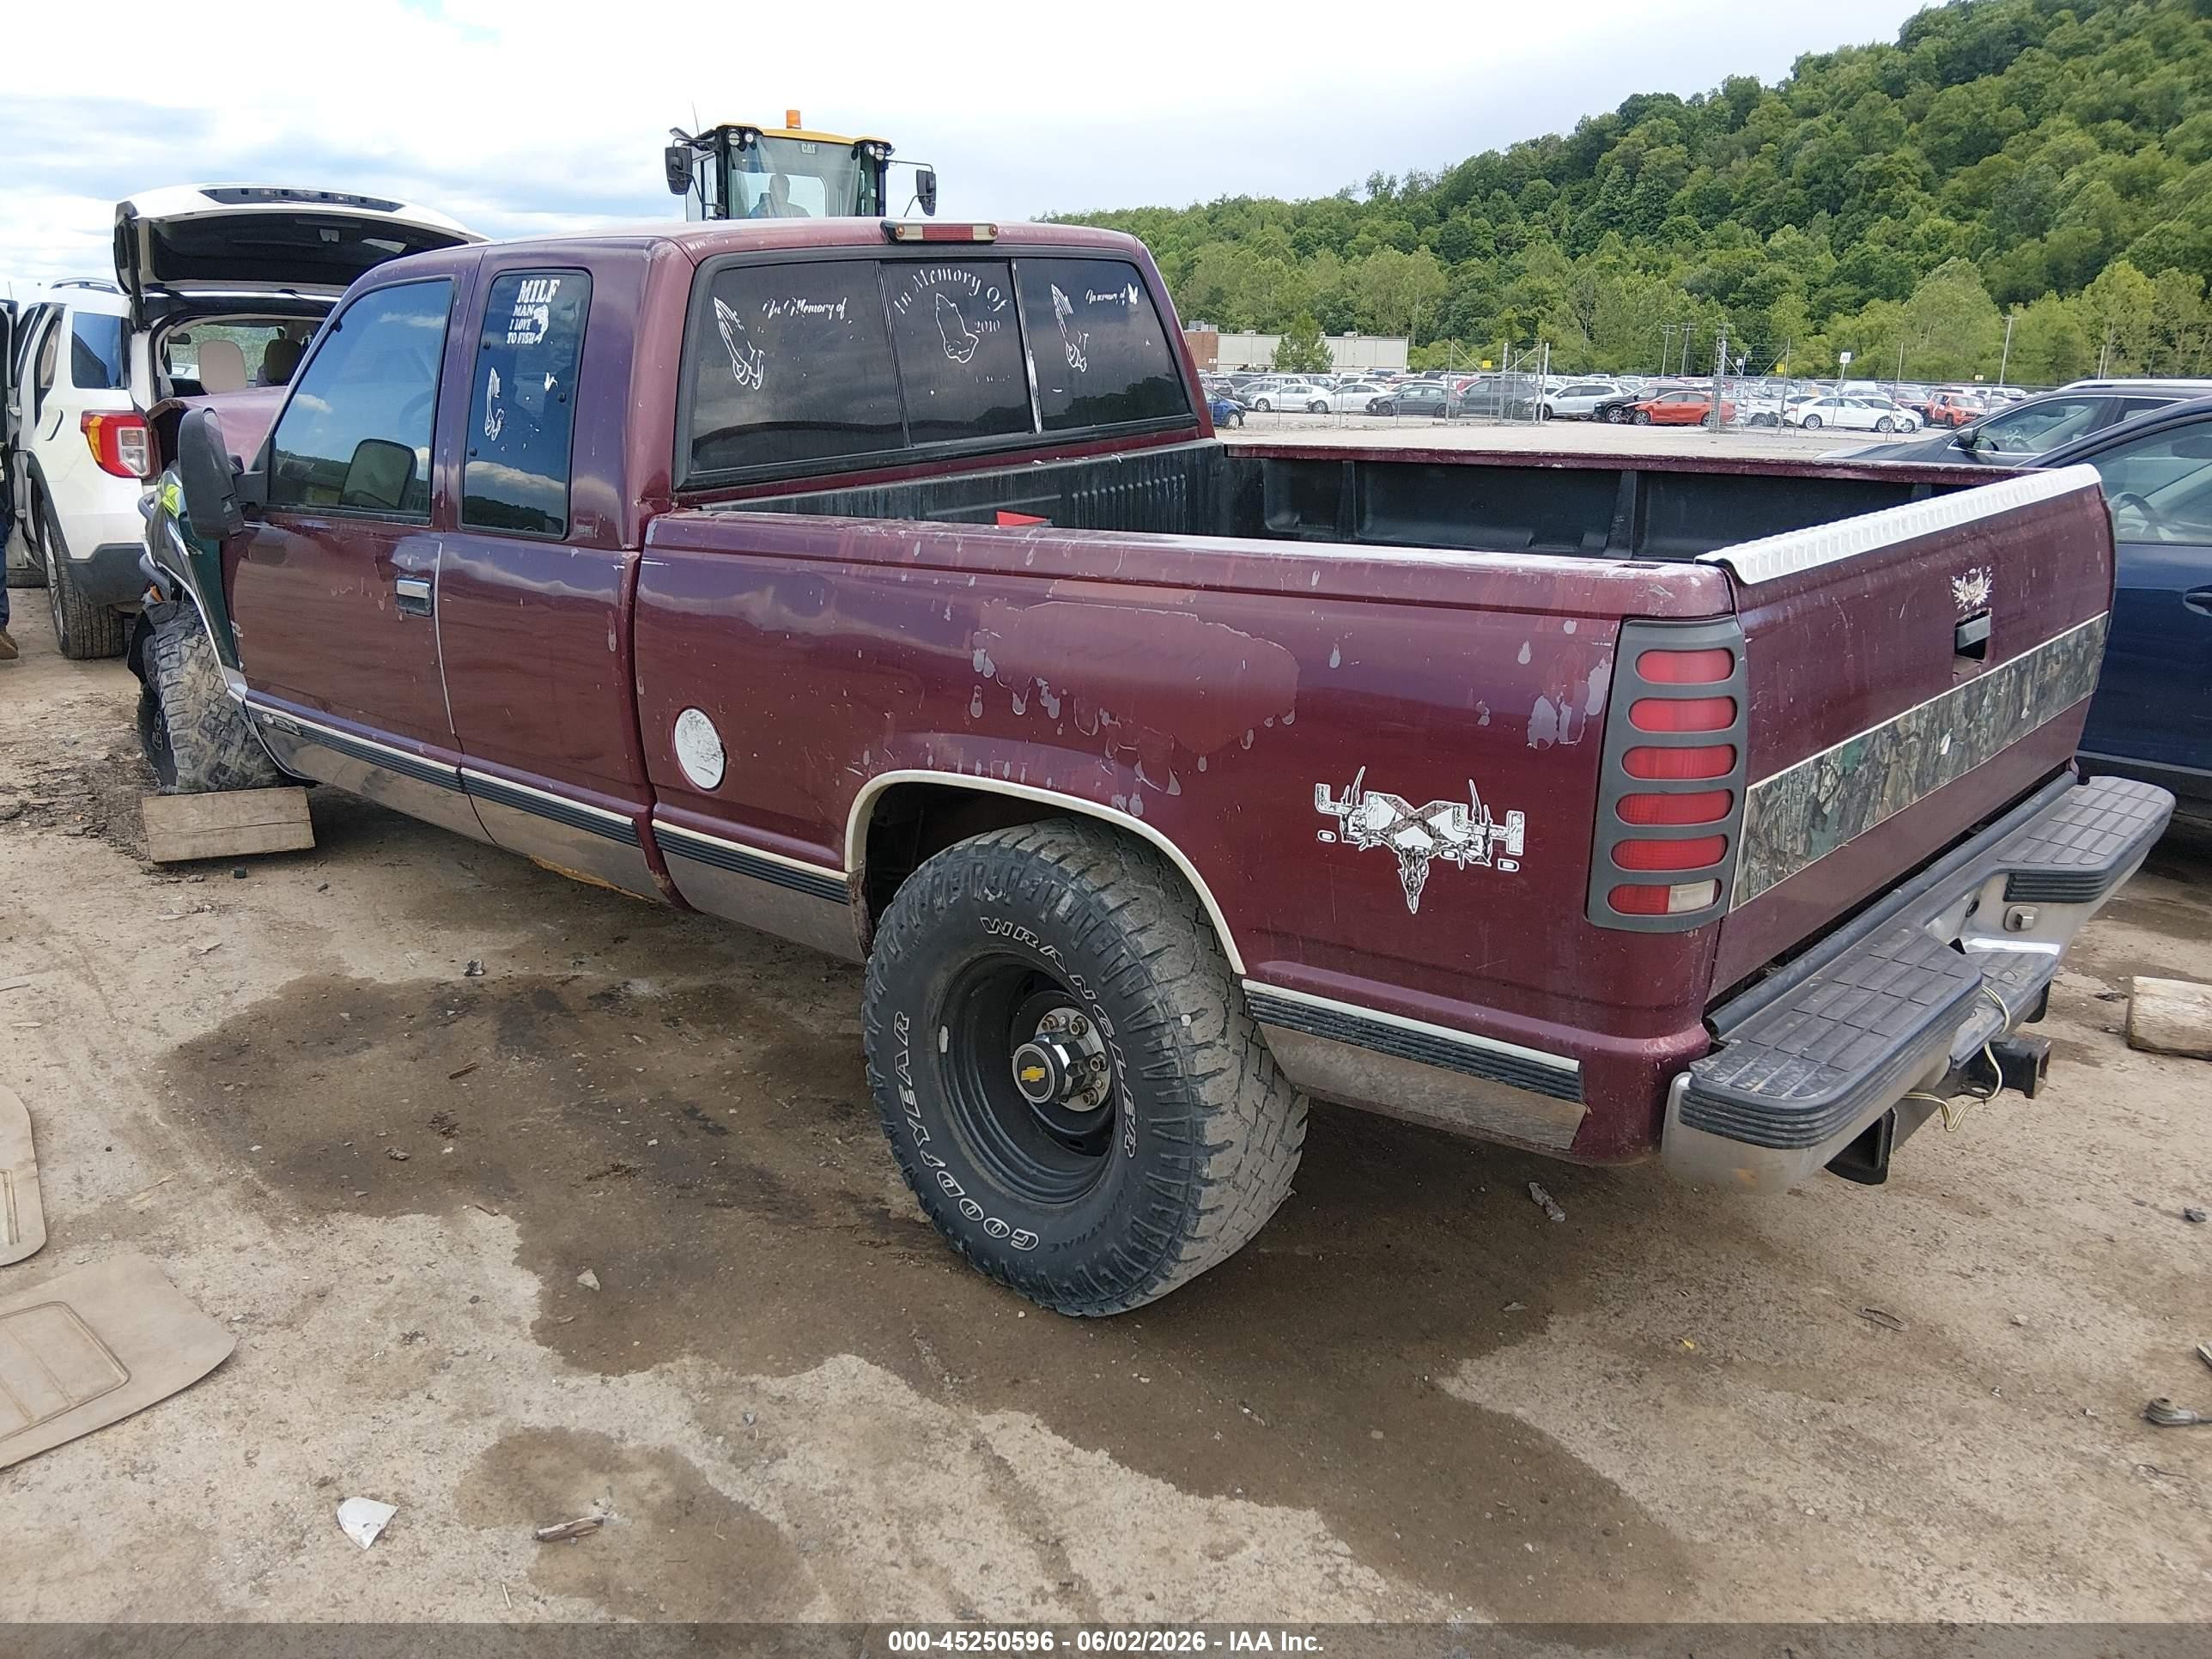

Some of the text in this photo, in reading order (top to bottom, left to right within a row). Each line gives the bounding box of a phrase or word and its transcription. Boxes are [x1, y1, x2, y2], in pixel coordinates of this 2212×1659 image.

[801, 143, 817, 155] CAT
[516, 279, 561, 303] MILF
[513, 304, 536, 317] MAN
[836, 296, 848, 320] of
[507, 331, 517, 344] TO
[980, 916, 1138, 1158] WRANGLER
[893, 1011, 1039, 1251] GOODYEAR
